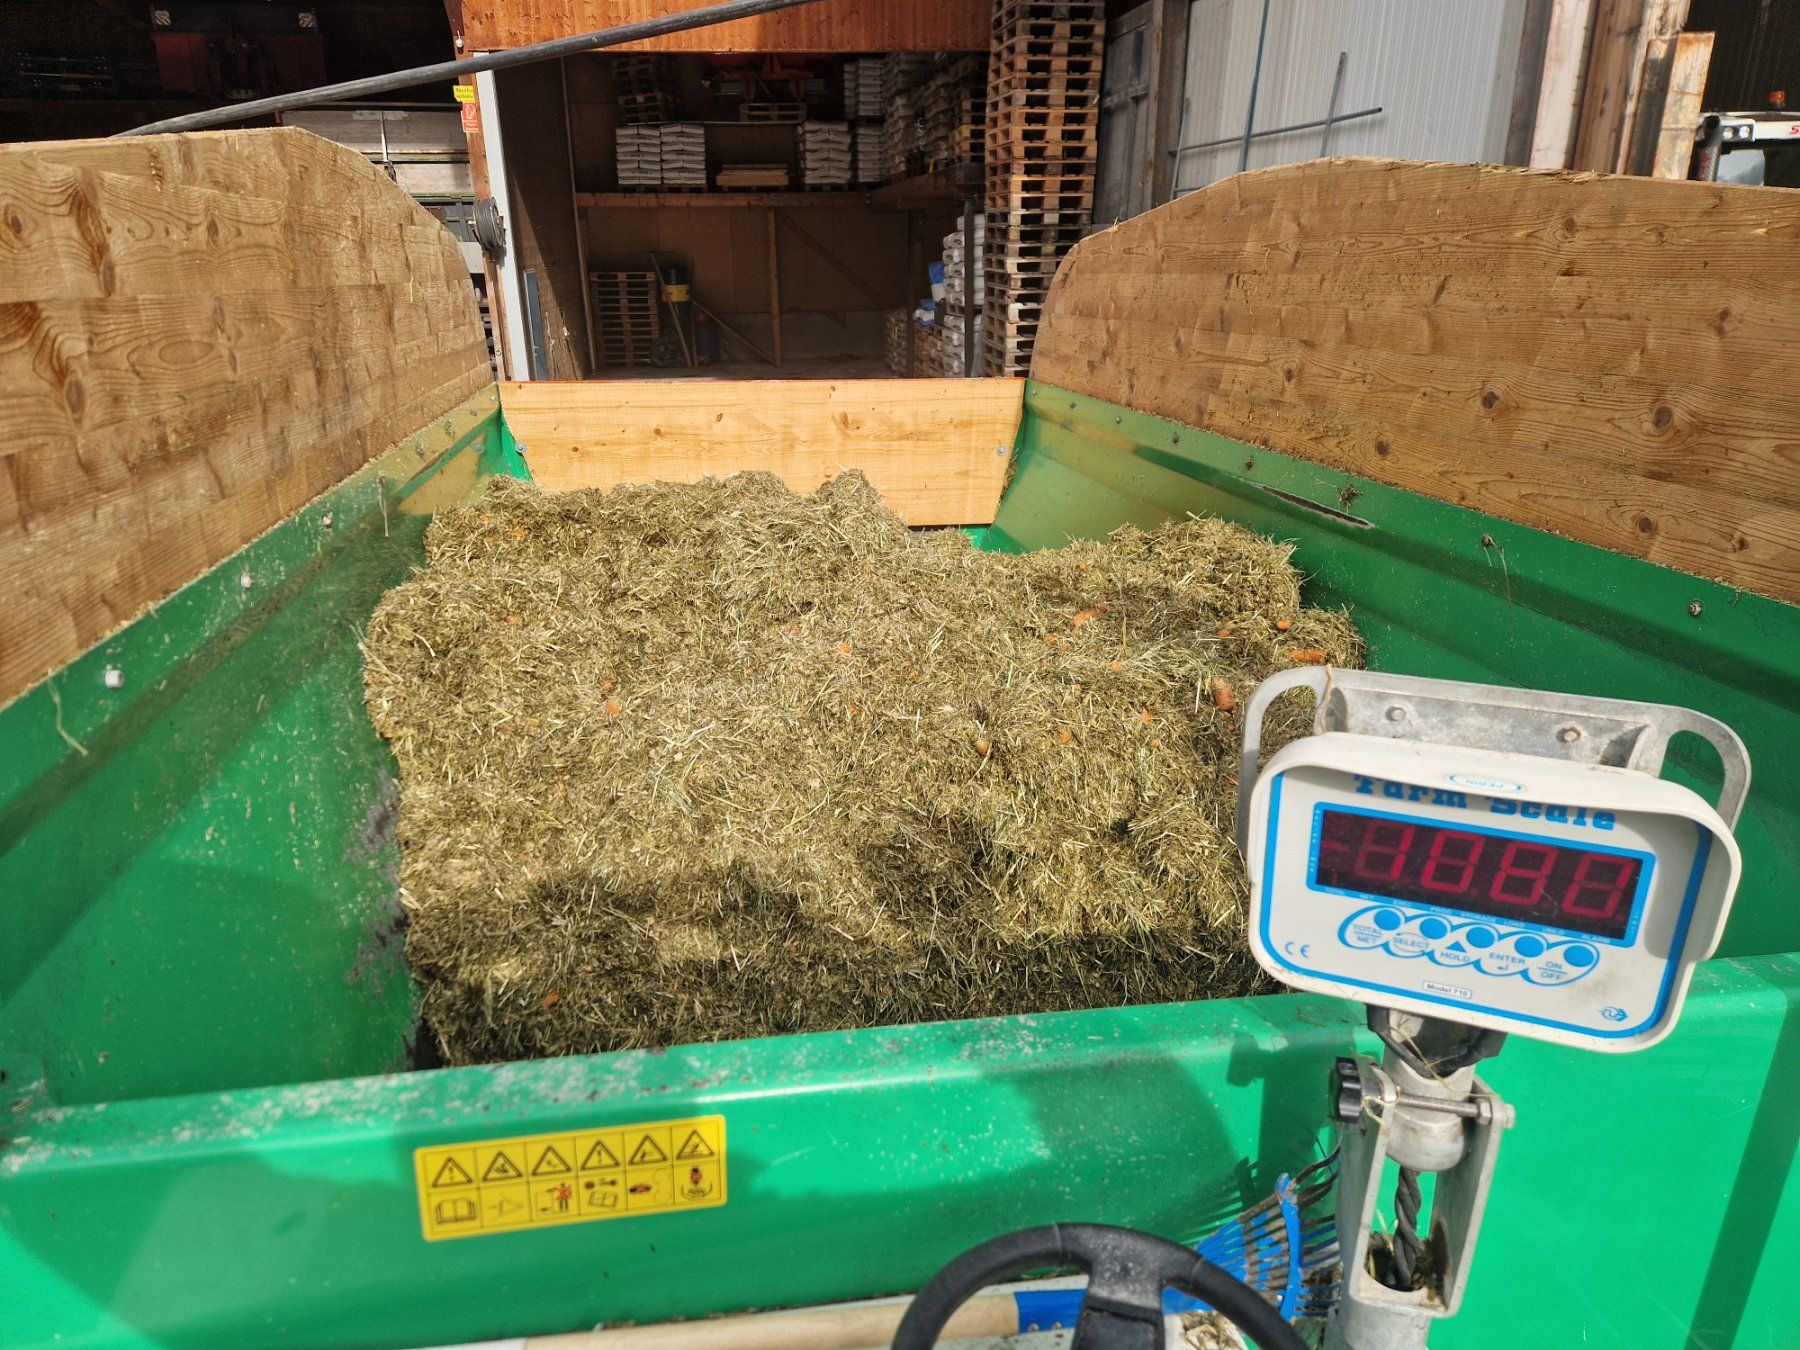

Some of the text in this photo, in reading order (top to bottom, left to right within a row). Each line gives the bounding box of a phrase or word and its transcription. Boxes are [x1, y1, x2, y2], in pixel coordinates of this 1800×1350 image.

[1487, 797, 1617, 832] Scale
[1353, 923, 1383, 936] TOTAL
[1357, 935, 1377, 944] NET
[1392, 936, 1430, 949] SELECT
[1440, 951, 1471, 963] HOLD
[1489, 952, 1526, 966] ENTER
[1545, 961, 1563, 971] ON
[1540, 971, 1564, 981] OFF
